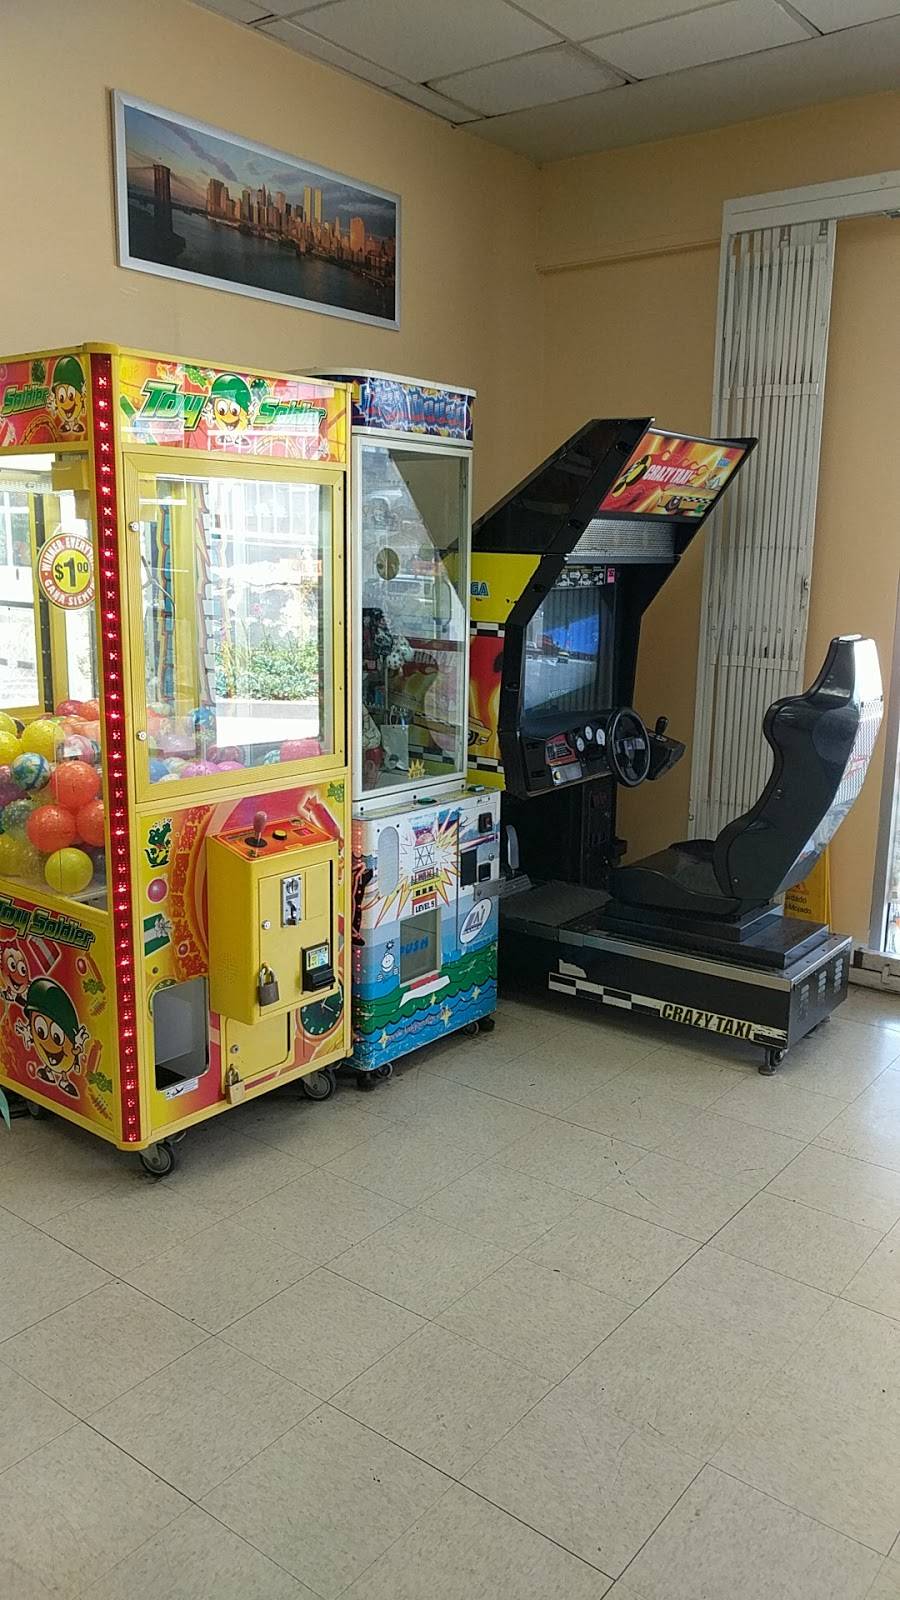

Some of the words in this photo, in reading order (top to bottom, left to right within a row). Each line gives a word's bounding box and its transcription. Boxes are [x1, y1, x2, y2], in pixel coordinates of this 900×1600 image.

[142, 380, 206, 431] Toy
[41, 539, 66, 572] WINNER
[415, 902, 430, 913] LEVEL
[29, 907, 95, 950] Soldier
[662, 1003, 714, 1029] CRAZY
[716, 1016, 753, 1040] TAXI
